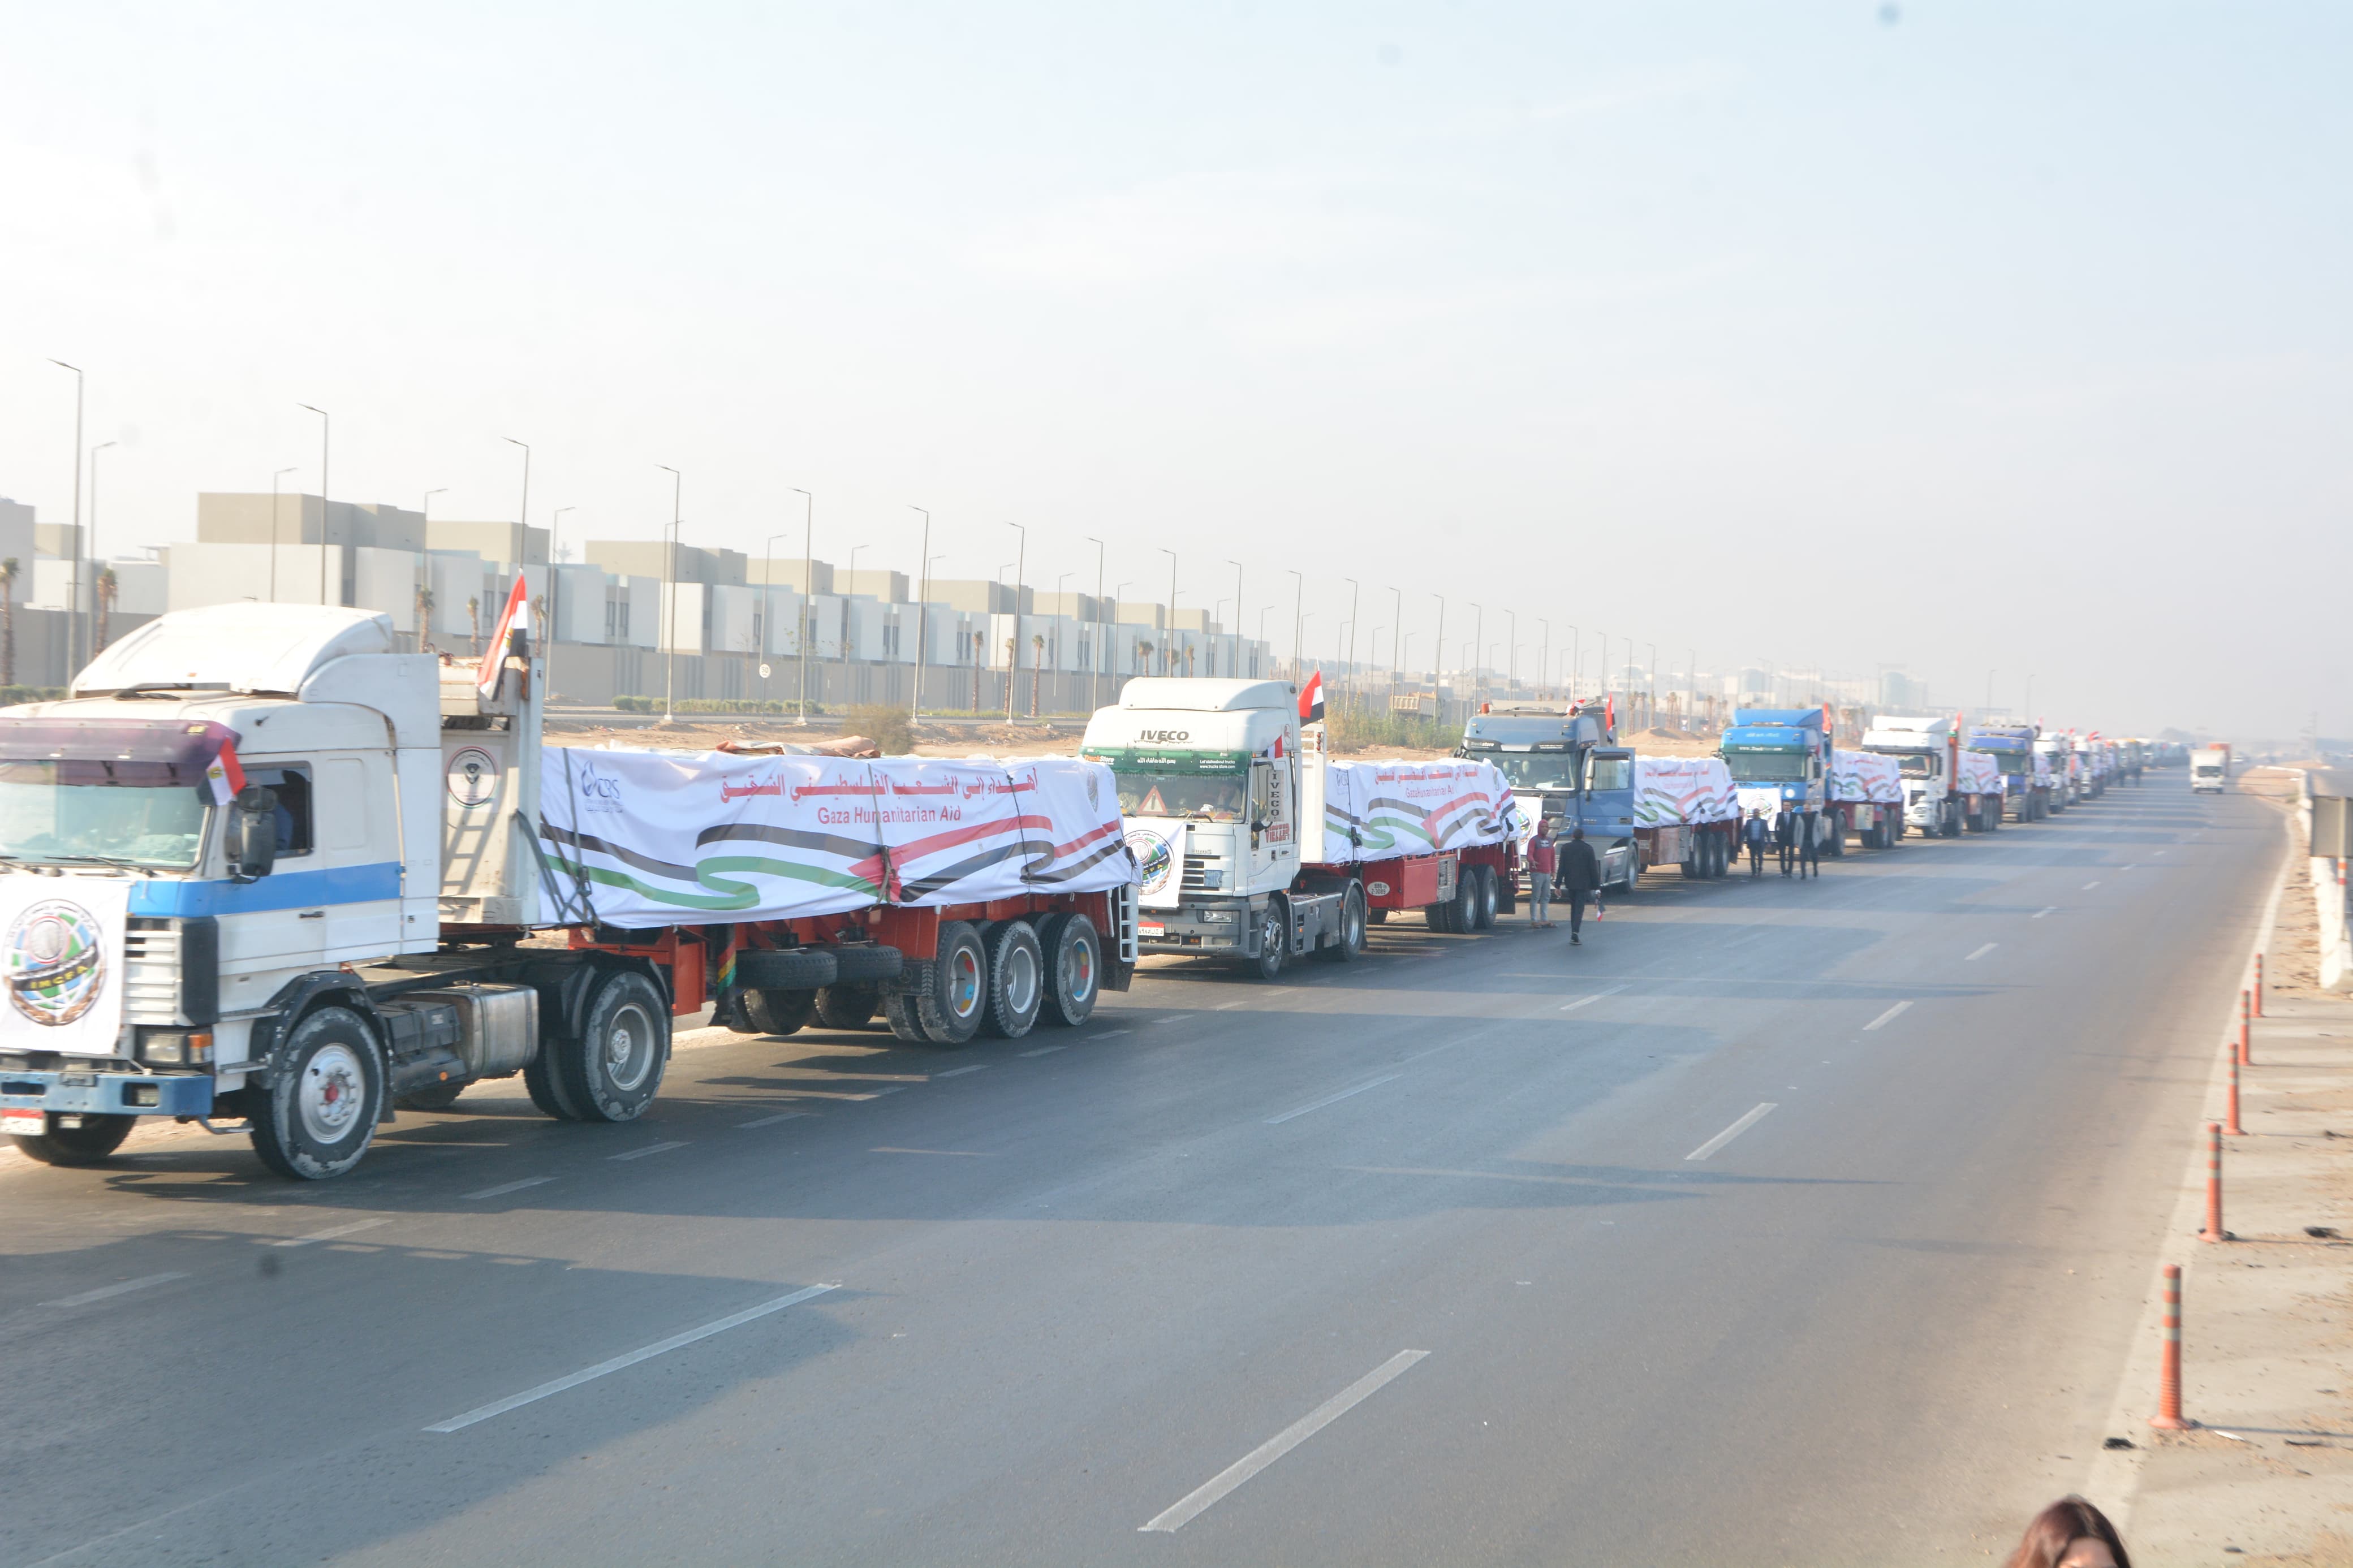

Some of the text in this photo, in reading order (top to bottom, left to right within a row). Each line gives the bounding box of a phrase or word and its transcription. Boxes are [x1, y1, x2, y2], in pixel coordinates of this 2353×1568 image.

[1140, 730, 1190, 740] IVECO
[720, 774, 785, 804] الشقيق
[790, 773, 890, 807] الفلسطيني
[892, 774, 958, 800] الشعب
[962, 775, 985, 801] إلى
[1270, 773, 1280, 817] IVECO
[818, 805, 961, 824] Gaza Humanitarian Aid
